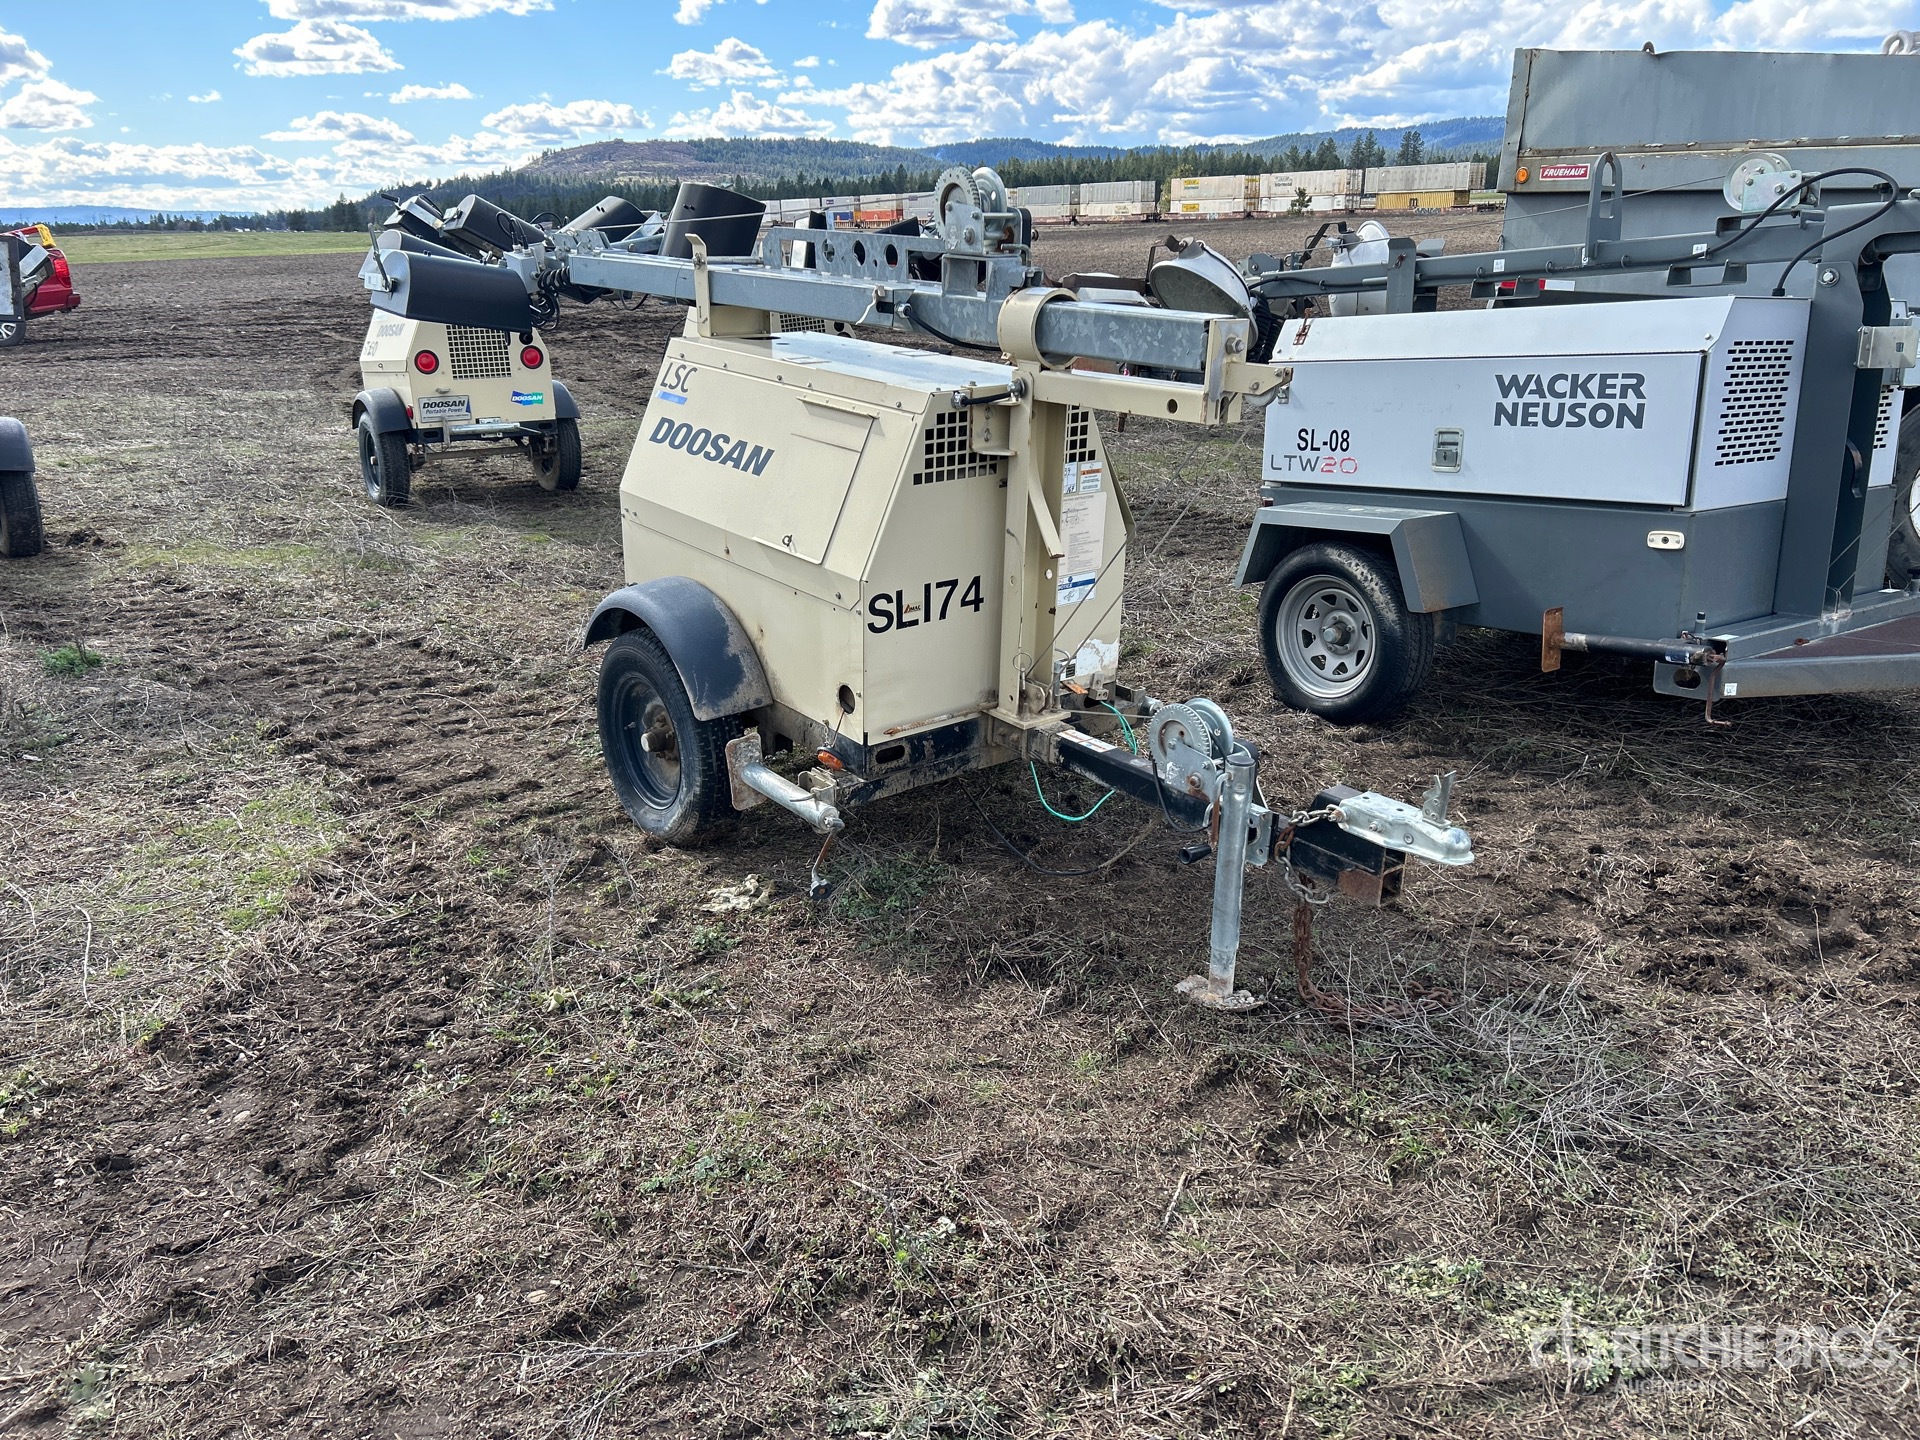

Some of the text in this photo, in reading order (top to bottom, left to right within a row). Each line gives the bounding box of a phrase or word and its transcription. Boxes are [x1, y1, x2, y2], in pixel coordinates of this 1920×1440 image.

[1543, 168, 1586, 177] FRUEHAUF
[660, 362, 698, 393] LSC
[1495, 373, 1647, 399] WACKER
[422, 399, 466, 409] DOOSAN
[1494, 402, 1645, 429] NEUSON
[649, 416, 775, 477] DOOSAN
[1297, 428, 1350, 453] SL-08
[1270, 454, 1358, 475] LTW20
[867, 575, 984, 634] SL174
